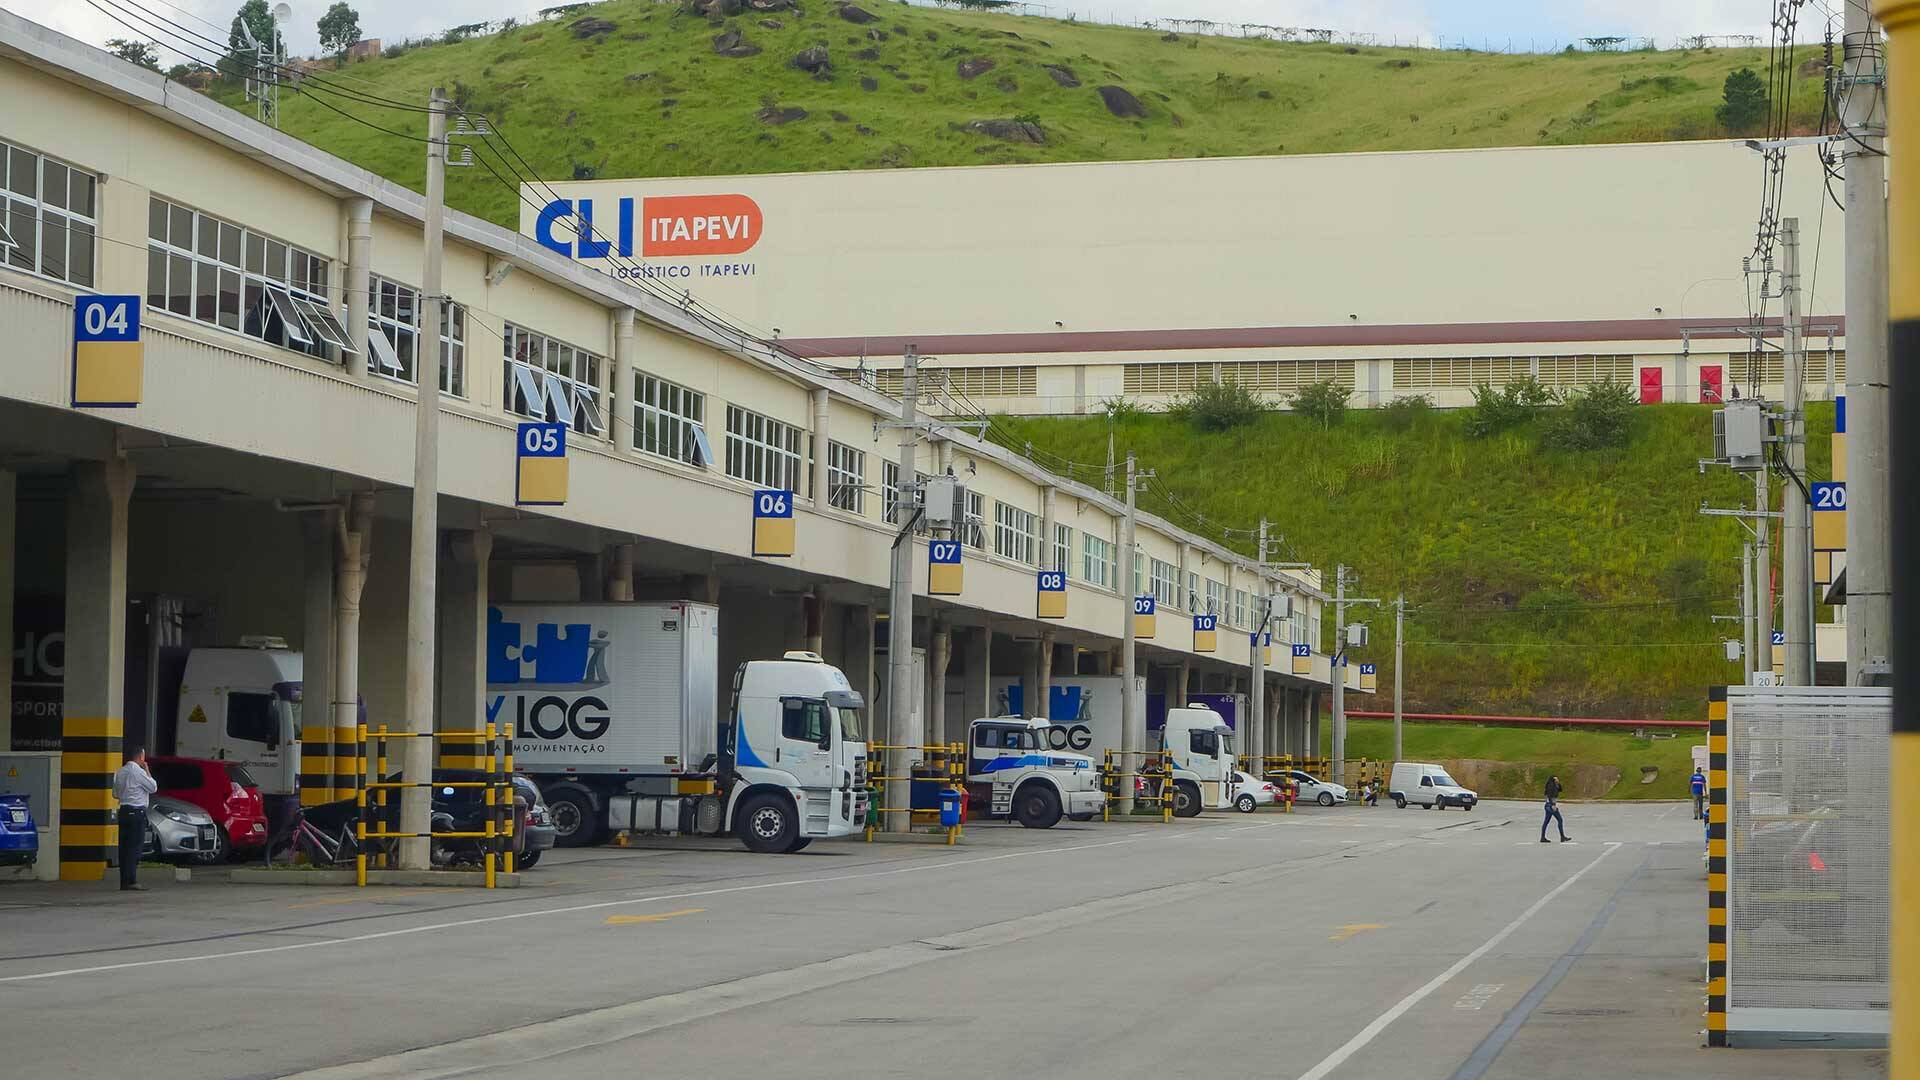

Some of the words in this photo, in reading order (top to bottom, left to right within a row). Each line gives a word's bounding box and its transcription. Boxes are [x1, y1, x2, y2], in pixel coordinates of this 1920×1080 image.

[535, 198, 634, 259] CLI
[651, 215, 749, 242] ITAPEVI
[610, 263, 691, 279] LOGÍSTICO
[700, 264, 756, 277] ITAPEVI
[85, 303, 128, 335] 04
[525, 428, 558, 452] 05
[760, 495, 786, 514] 06
[1818, 487, 1846, 507] 20
[934, 544, 956, 560] 07
[1041, 574, 1061, 588] 08
[1134, 600, 1151, 612] 09
[1197, 618, 1212, 629] 10
[1295, 646, 1308, 655] 12
[1362, 665, 1373, 673] 14
[1759, 677, 1770, 687] 20
[517, 696, 611, 740] LOG
[1049, 725, 1092, 750] OG
[513, 743, 605, 753] MOVIMENTAÇÃO
